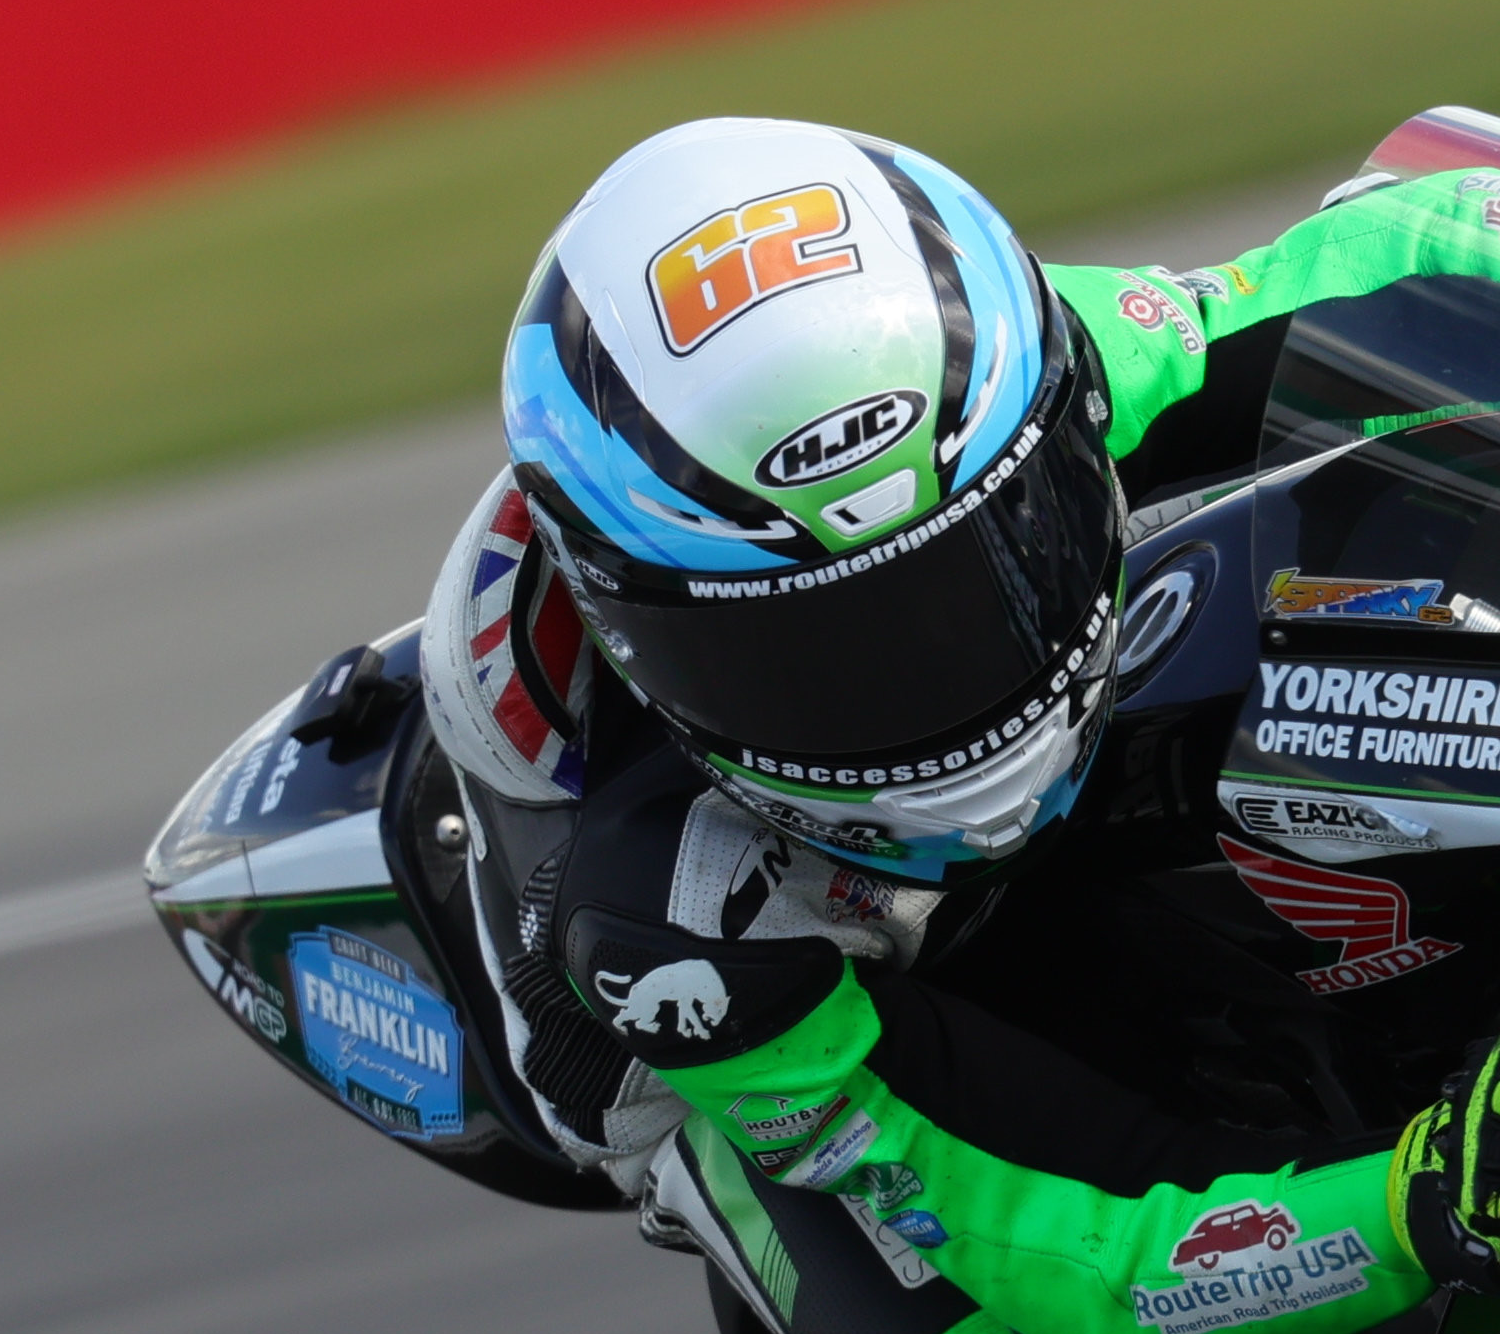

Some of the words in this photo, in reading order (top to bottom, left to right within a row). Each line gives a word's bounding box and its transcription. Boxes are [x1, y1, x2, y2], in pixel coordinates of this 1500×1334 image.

[647, 183, 862, 357] 62
[780, 398, 898, 478] HJC
[816, 440, 883, 475] HELMETS
[688, 423, 1044, 599] www.routetripusa.co.uk
[742, 591, 1112, 785] jsaccessories.co.uk
[1256, 721, 1350, 760] OFFICE
[1293, 827, 1350, 839] RACING
[1355, 831, 1435, 847] PRODUCTS
[331, 961, 415, 1014] BENJAMIN
[1300, 938, 1459, 994] HONDA
[304, 970, 448, 1075] FRANKLIN
[833, 1121, 872, 1158] Workshop
[1133, 1261, 1293, 1321] RouteTrip
[1297, 1233, 1370, 1278] USA
[1234, 1305, 1270, 1320] Road
[1271, 1297, 1299, 1311] Trip
[1300, 1276, 1364, 1304] Holidays
